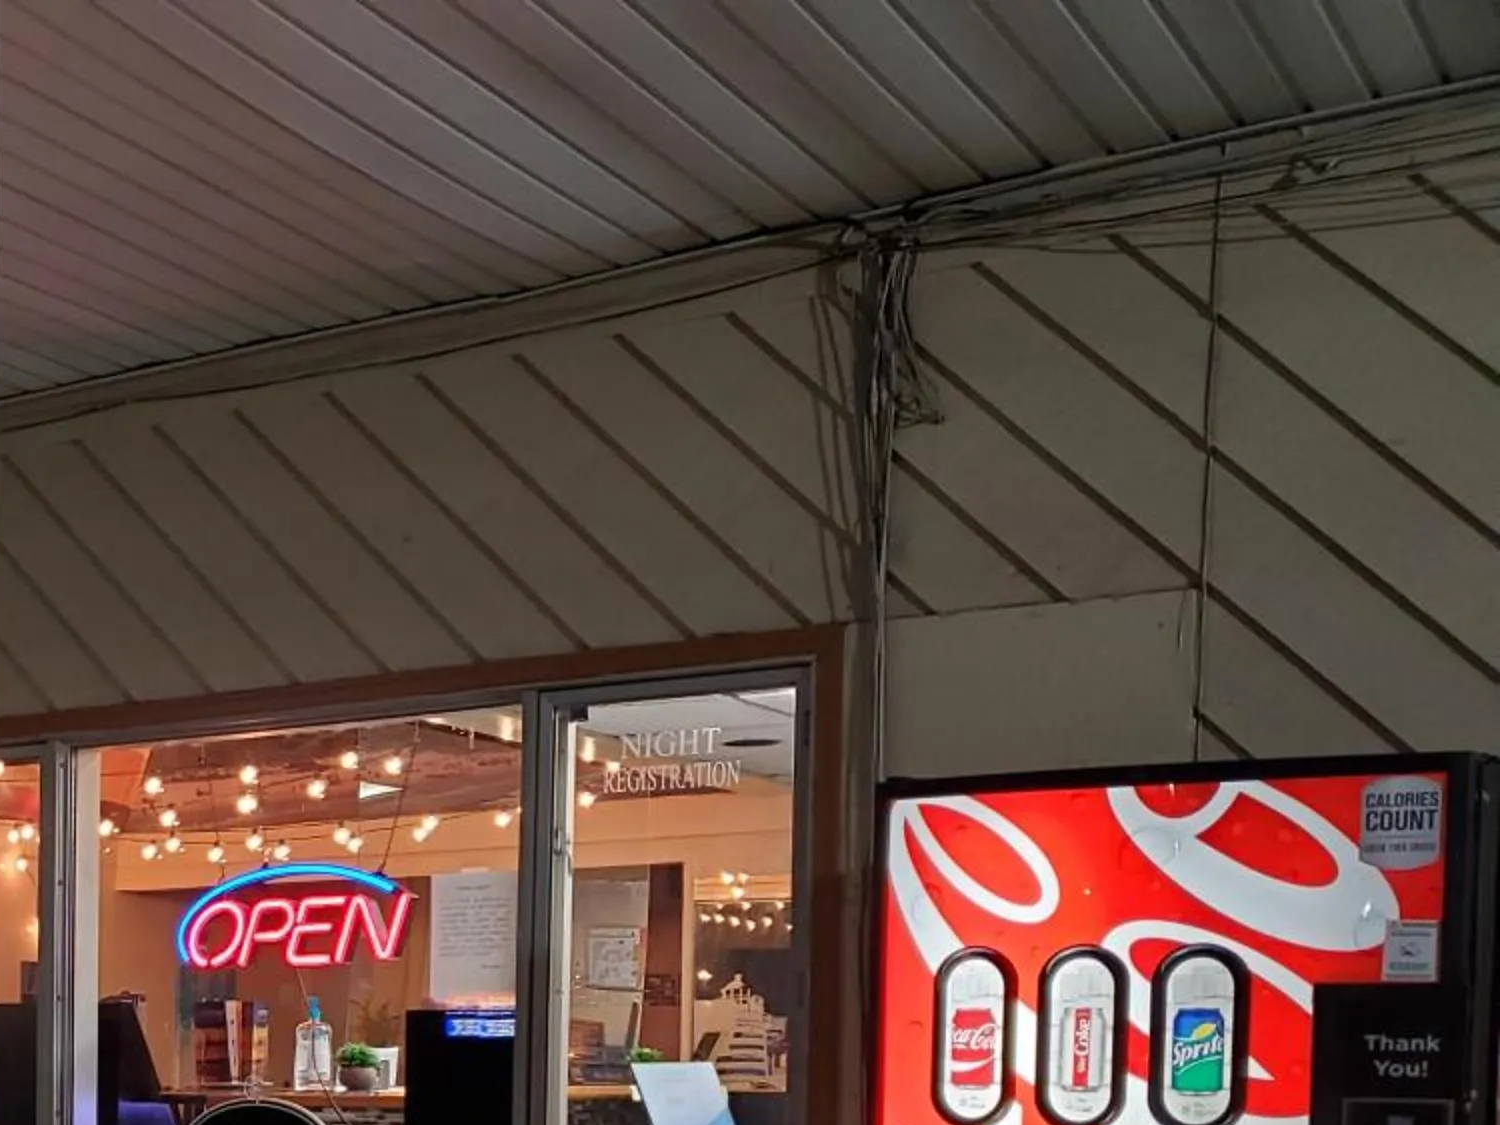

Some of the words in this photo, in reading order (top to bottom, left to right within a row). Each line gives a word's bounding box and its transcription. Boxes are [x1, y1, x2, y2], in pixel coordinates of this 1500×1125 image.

[621, 727, 722, 759] NIGHT
[603, 760, 740, 794] REGISTRATION
[1366, 791, 1439, 809] CALORIES
[1366, 809, 1438, 832] COUNT
[187, 893, 411, 967] OPEN
[1363, 1033, 1442, 1053] Thank
[1372, 1059, 1429, 1078] You!
